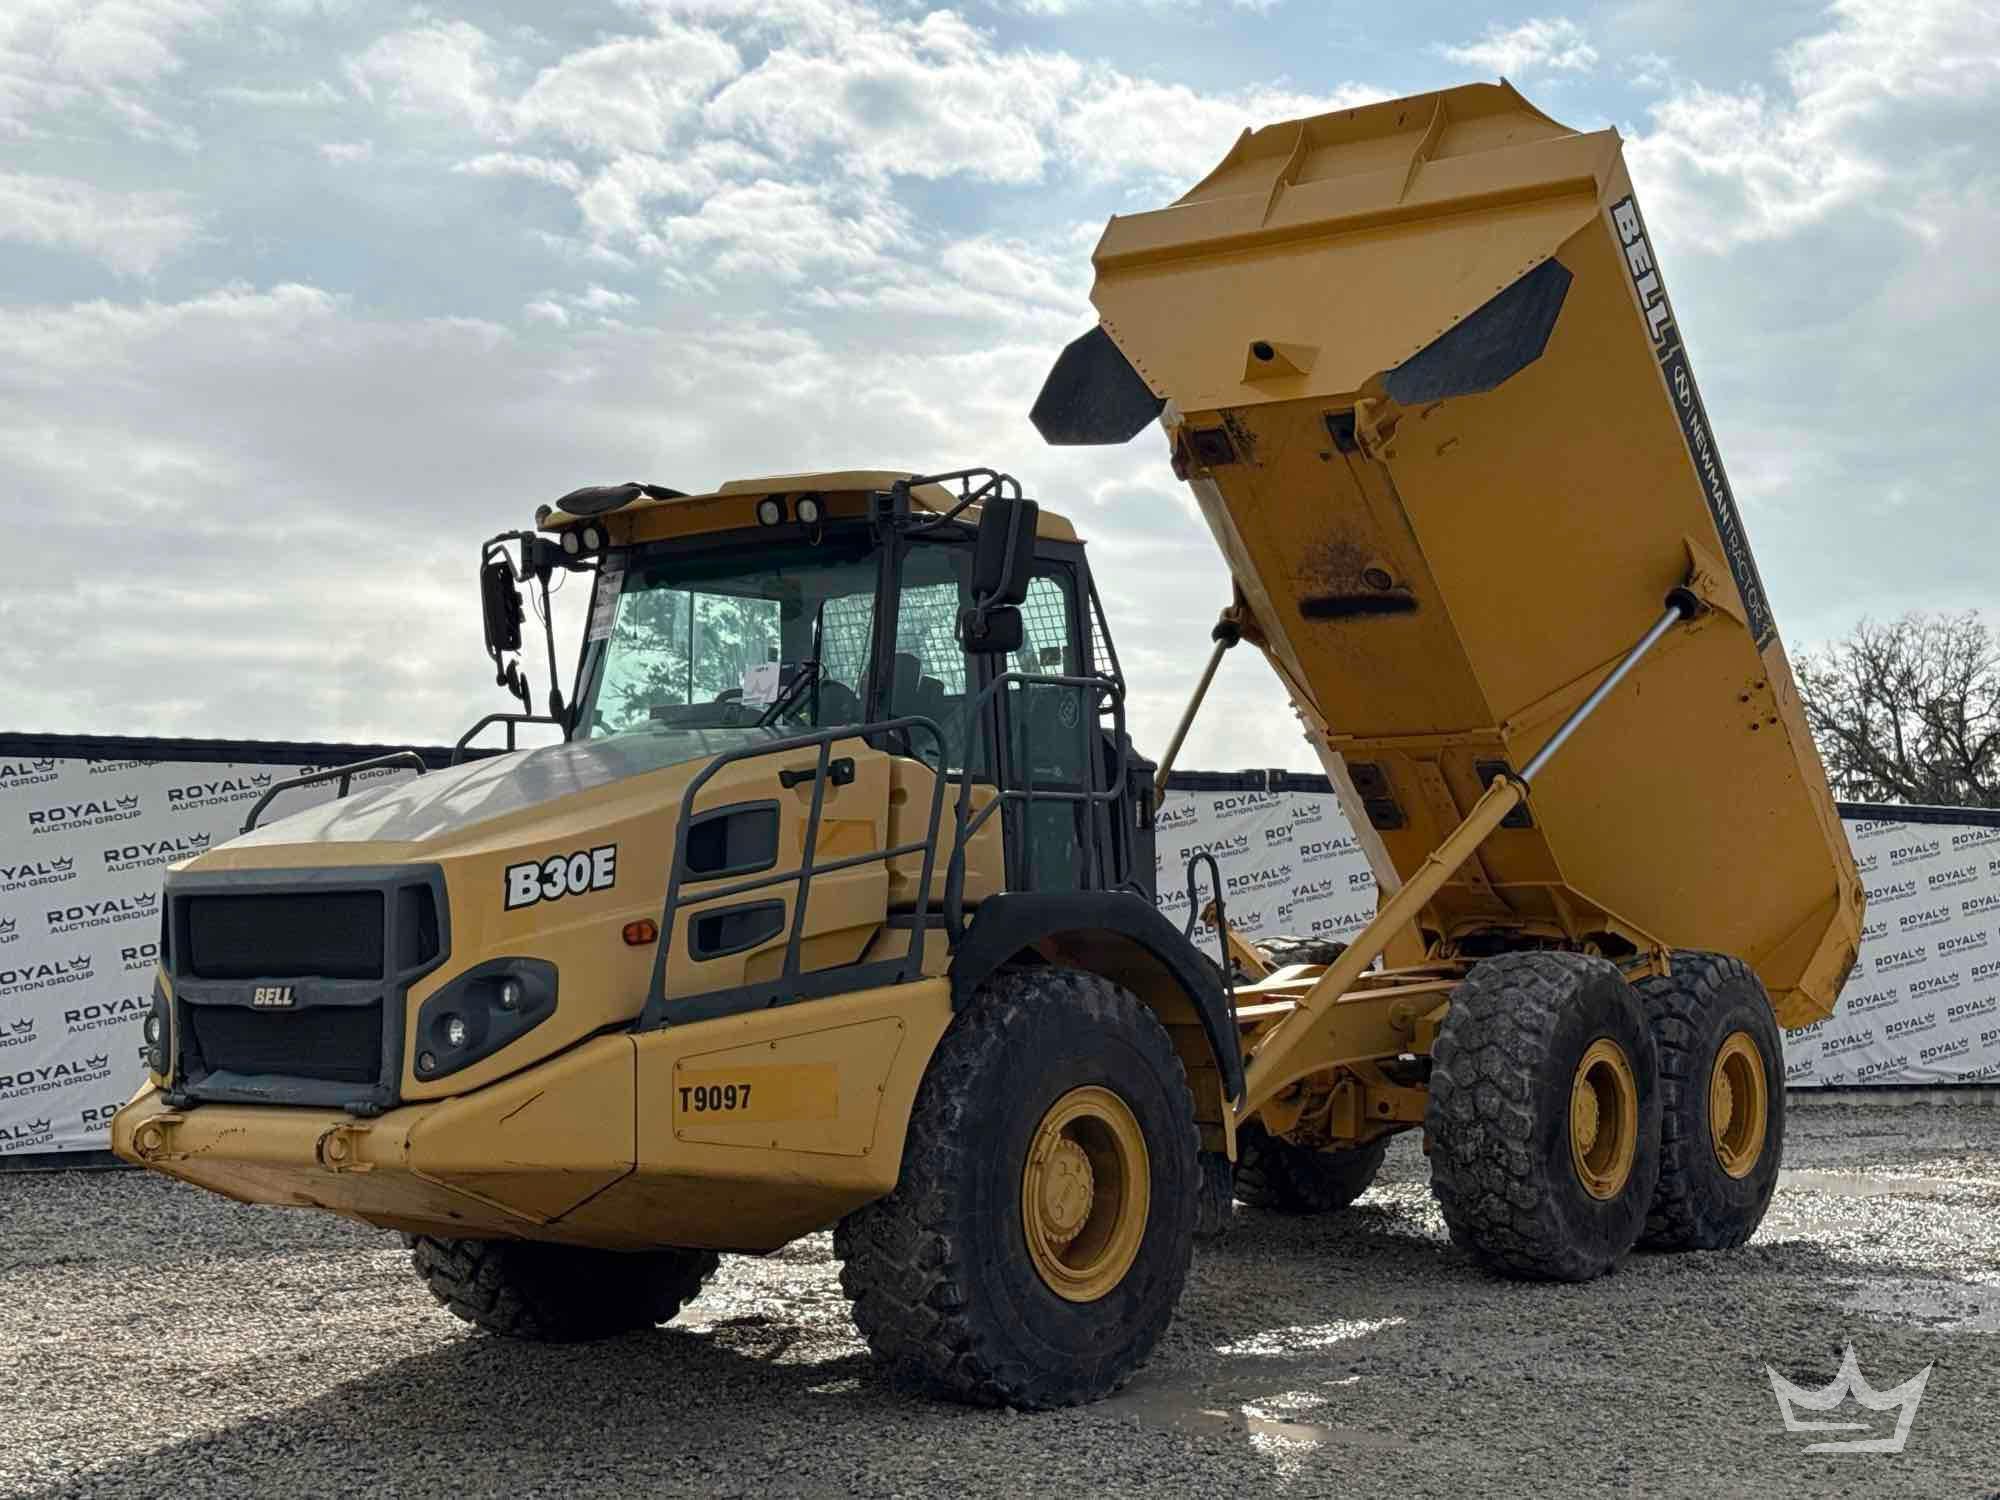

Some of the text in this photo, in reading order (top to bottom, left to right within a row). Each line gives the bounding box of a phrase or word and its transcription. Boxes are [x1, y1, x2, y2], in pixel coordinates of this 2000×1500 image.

[1611, 196, 1669, 340] BELL
[11, 773, 58, 788] GROUP
[168, 778, 251, 802] ROYAL
[171, 790, 266, 812] AUCTION GROU
[1214, 791, 1267, 811] ROYAL
[29, 800, 116, 825] ROYAL
[1154, 809, 1181, 823] YAL
[32, 810, 142, 835] AUCTION GROUP
[1265, 824, 1294, 841] ROY
[1952, 831, 1990, 845] ROYAL
[104, 838, 189, 863] ROYAL
[1180, 840, 1234, 859] ROYAL
[1300, 838, 1351, 856] ROYAL
[1890, 843, 1929, 859] ROYAL
[0, 863, 51, 880] YAL
[107, 856, 166, 872] AUCTION
[29, 872, 77, 887] GROUP
[504, 844, 617, 911] B30E
[1227, 868, 1279, 889] ROYAL
[1928, 869, 1967, 885] ROYAL
[1292, 883, 1319, 897] YAL
[1864, 883, 1905, 898] ROYAL
[1962, 895, 2000, 910] ROYAL
[47, 899, 134, 924] ROYAL
[1899, 909, 1939, 926] ROYAL
[50, 908, 159, 934] AUCTION GROUP
[1311, 912, 1362, 932] ROYAL
[1938, 934, 1976, 951] ROYAL
[124, 958, 159, 970] AUCT
[1875, 950, 1915, 966] ROYAL
[0, 962, 69, 985] OYAL
[1971, 961, 2000, 976] ROYA
[0, 970, 95, 996] CTION GROUP
[1910, 976, 1949, 992] ROYAL
[254, 988, 293, 1006] BELL
[1847, 992, 1887, 1009] ROYAL
[64, 997, 151, 1024] ROYAL
[1947, 1000, 1986, 1016] ROYAL
[68, 1015, 127, 1034] AUCTION
[1886, 1017, 1925, 1034] ROYAL
[0, 1033, 37, 1048] ROUP
[1822, 1034, 1862, 1050] ROYAL
[1920, 1041, 1958, 1059] ROYAL
[1857, 1057, 1897, 1076] ROYAL
[0, 1062, 86, 1090] ROYAL
[1, 1070, 112, 1100] AUCTION GROUP
[679, 1084, 752, 1112] T9097
[5, 1134, 54, 1150] GROUP
